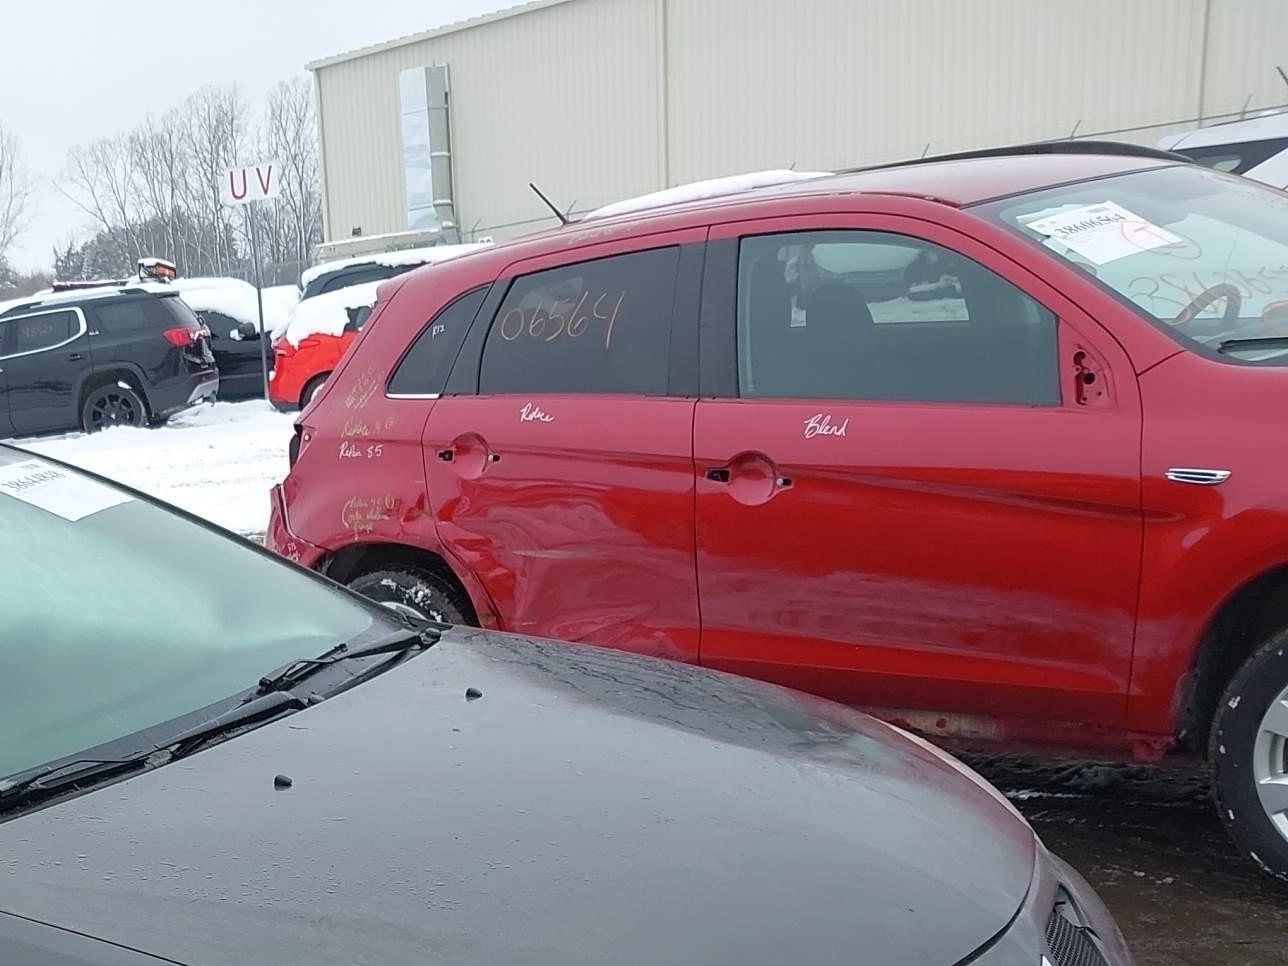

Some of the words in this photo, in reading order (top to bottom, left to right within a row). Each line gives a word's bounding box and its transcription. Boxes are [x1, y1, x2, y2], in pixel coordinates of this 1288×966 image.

[229, 168, 247, 200] U
[256, 165, 272, 195] V
[501, 290, 626, 349] 06564
[804, 413, 849, 439] Blend
